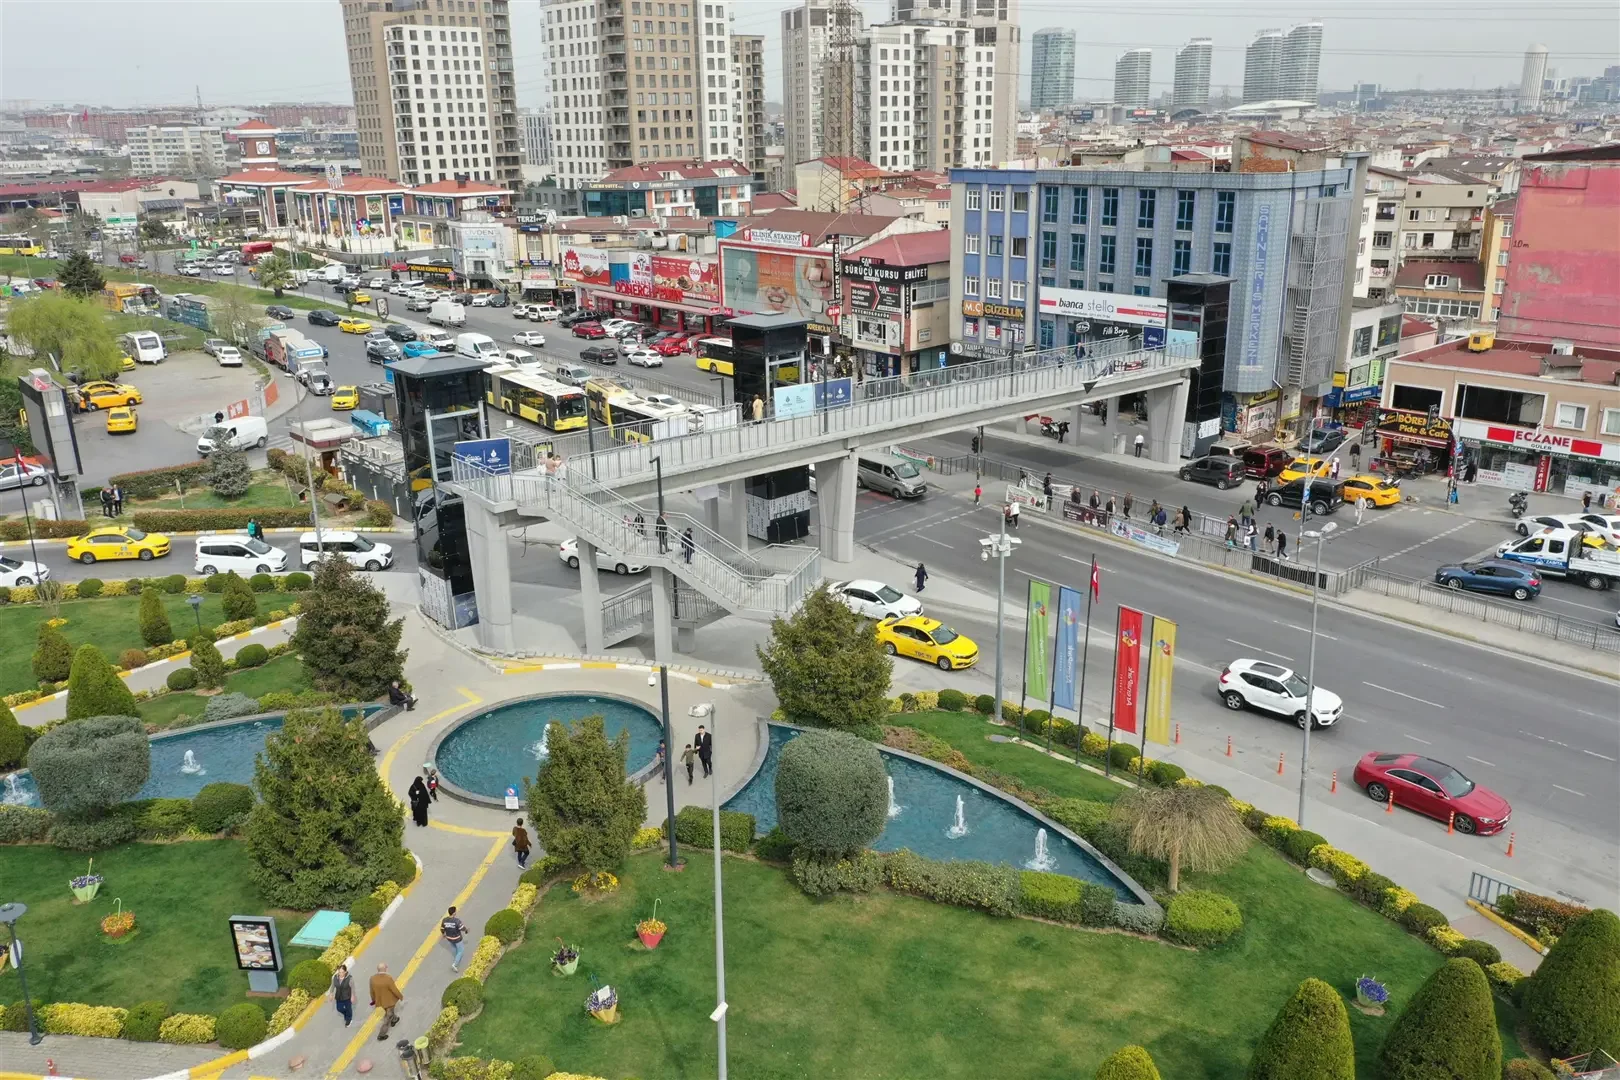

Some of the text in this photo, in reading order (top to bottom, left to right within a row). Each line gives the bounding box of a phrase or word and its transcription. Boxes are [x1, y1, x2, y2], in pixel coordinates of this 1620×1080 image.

[844, 264, 873, 277] SÜRÜCÜ
[874, 268, 899, 280] KURSU
[904, 268, 928, 280] EHLİYET
[984, 304, 1024, 318] GÜZELLİK
[1058, 298, 1114, 312] bianca stella
[1399, 424, 1448, 438] Pide & Cafe
[1516, 430, 1570, 448] ECZANE
[1536, 456, 1547, 490] ECZANE
